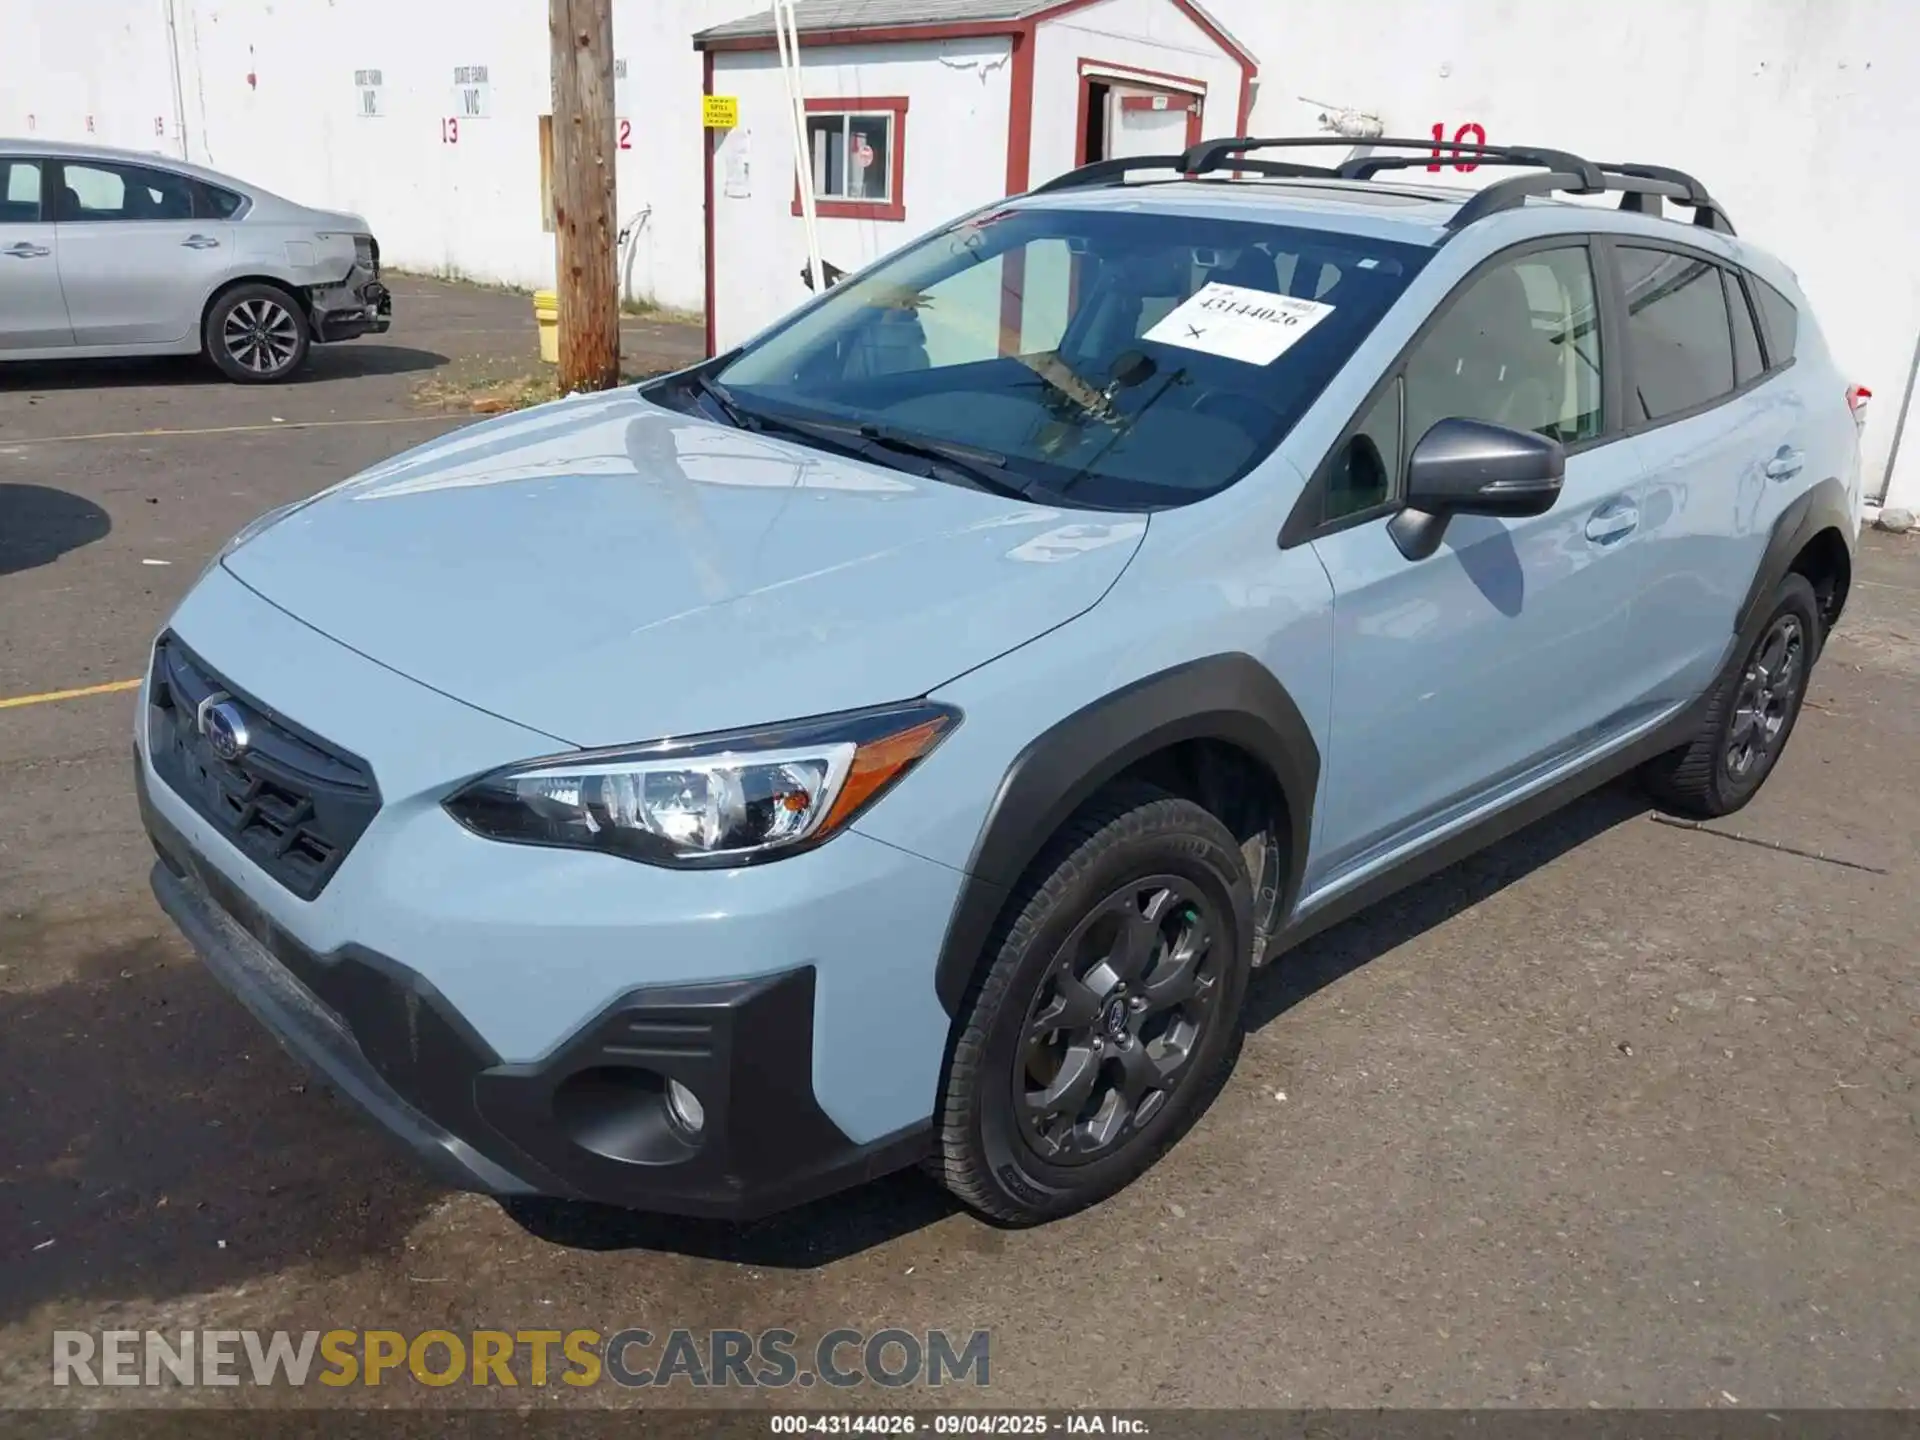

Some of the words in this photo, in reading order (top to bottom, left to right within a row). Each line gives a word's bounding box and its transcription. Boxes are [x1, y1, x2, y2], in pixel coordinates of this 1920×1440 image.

[363, 90, 376, 115] VIC
[463, 88, 480, 115] VIC
[442, 118, 458, 144] 13
[615, 120, 632, 150] 2
[1426, 123, 1486, 173] 10
[1200, 298, 1299, 327] 43144026
